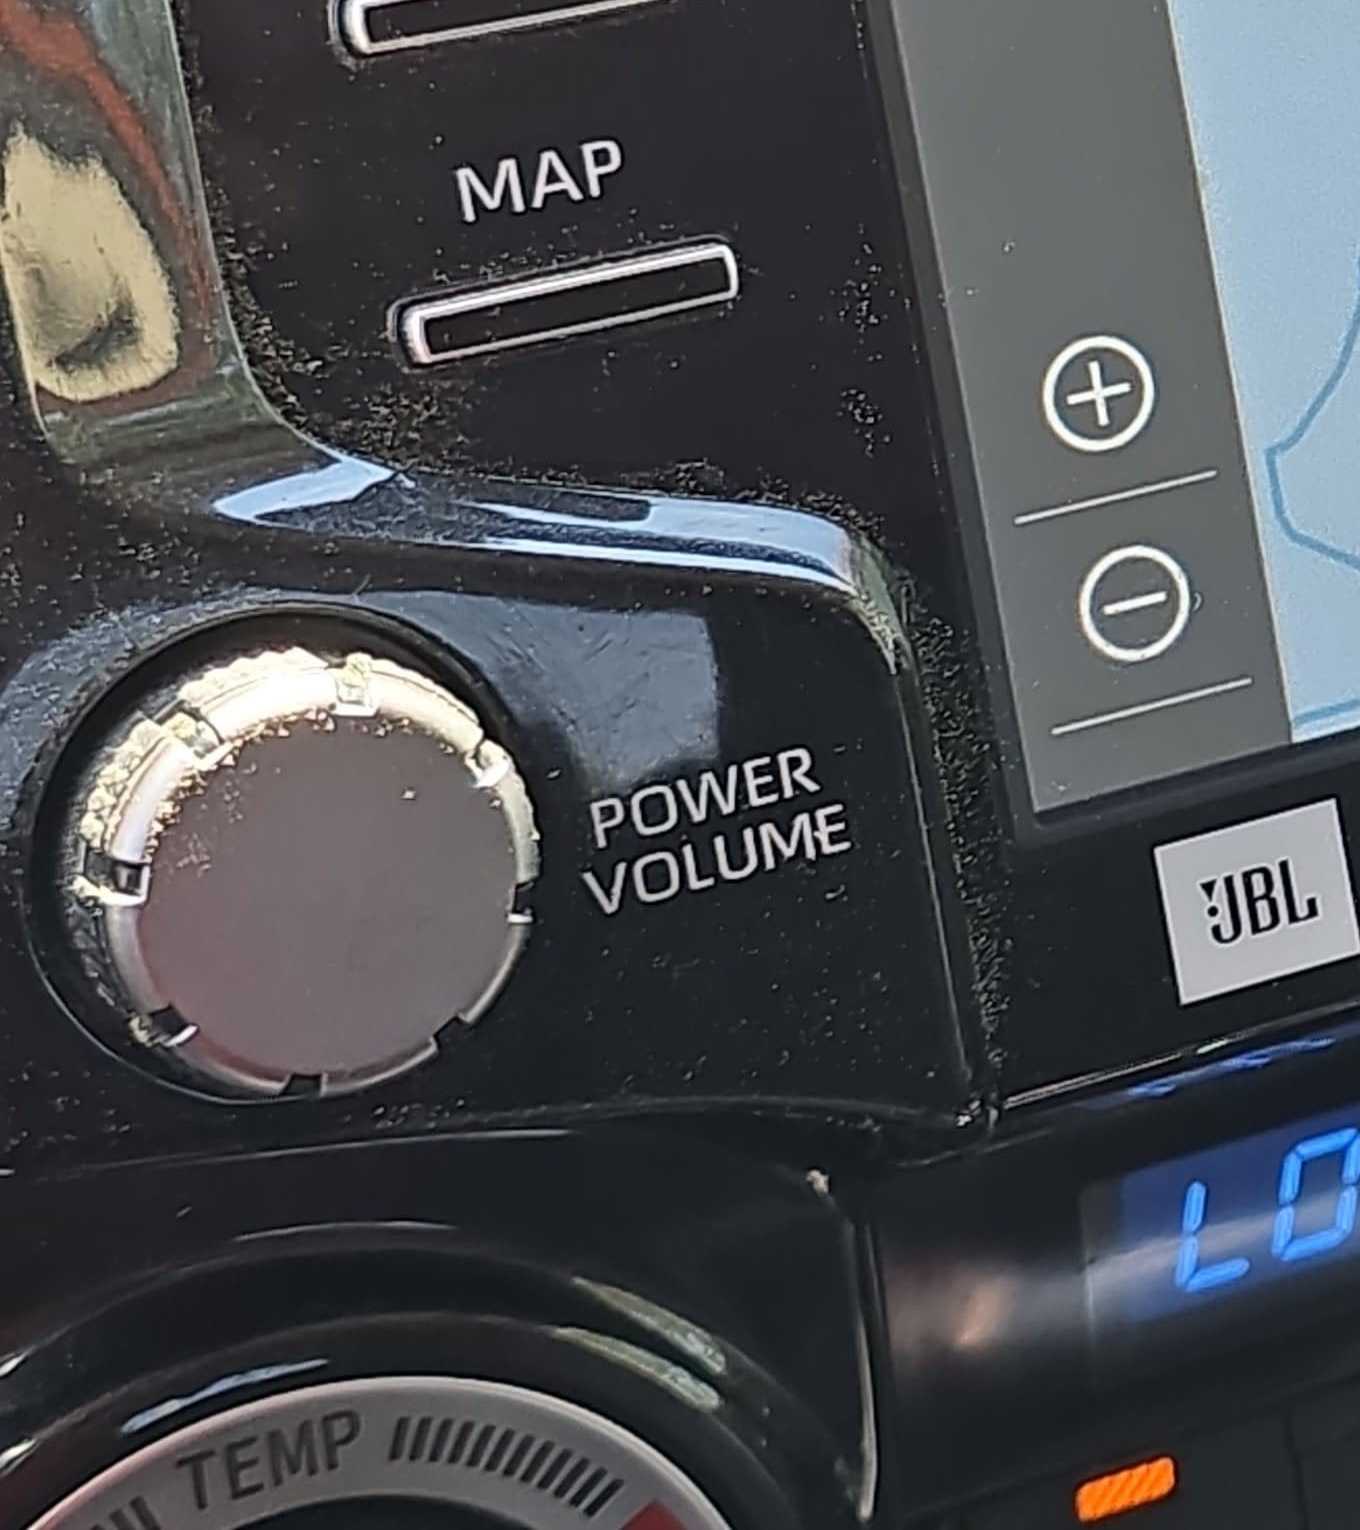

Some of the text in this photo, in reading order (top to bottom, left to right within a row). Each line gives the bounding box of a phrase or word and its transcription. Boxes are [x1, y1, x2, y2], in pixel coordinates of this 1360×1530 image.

[453, 138, 625, 222] MAP
[590, 747, 822, 850] POWER
[582, 803, 853, 917] VOLUME
[1200, 857, 1320, 946] JBL
[178, 1408, 364, 1512] TEMP
